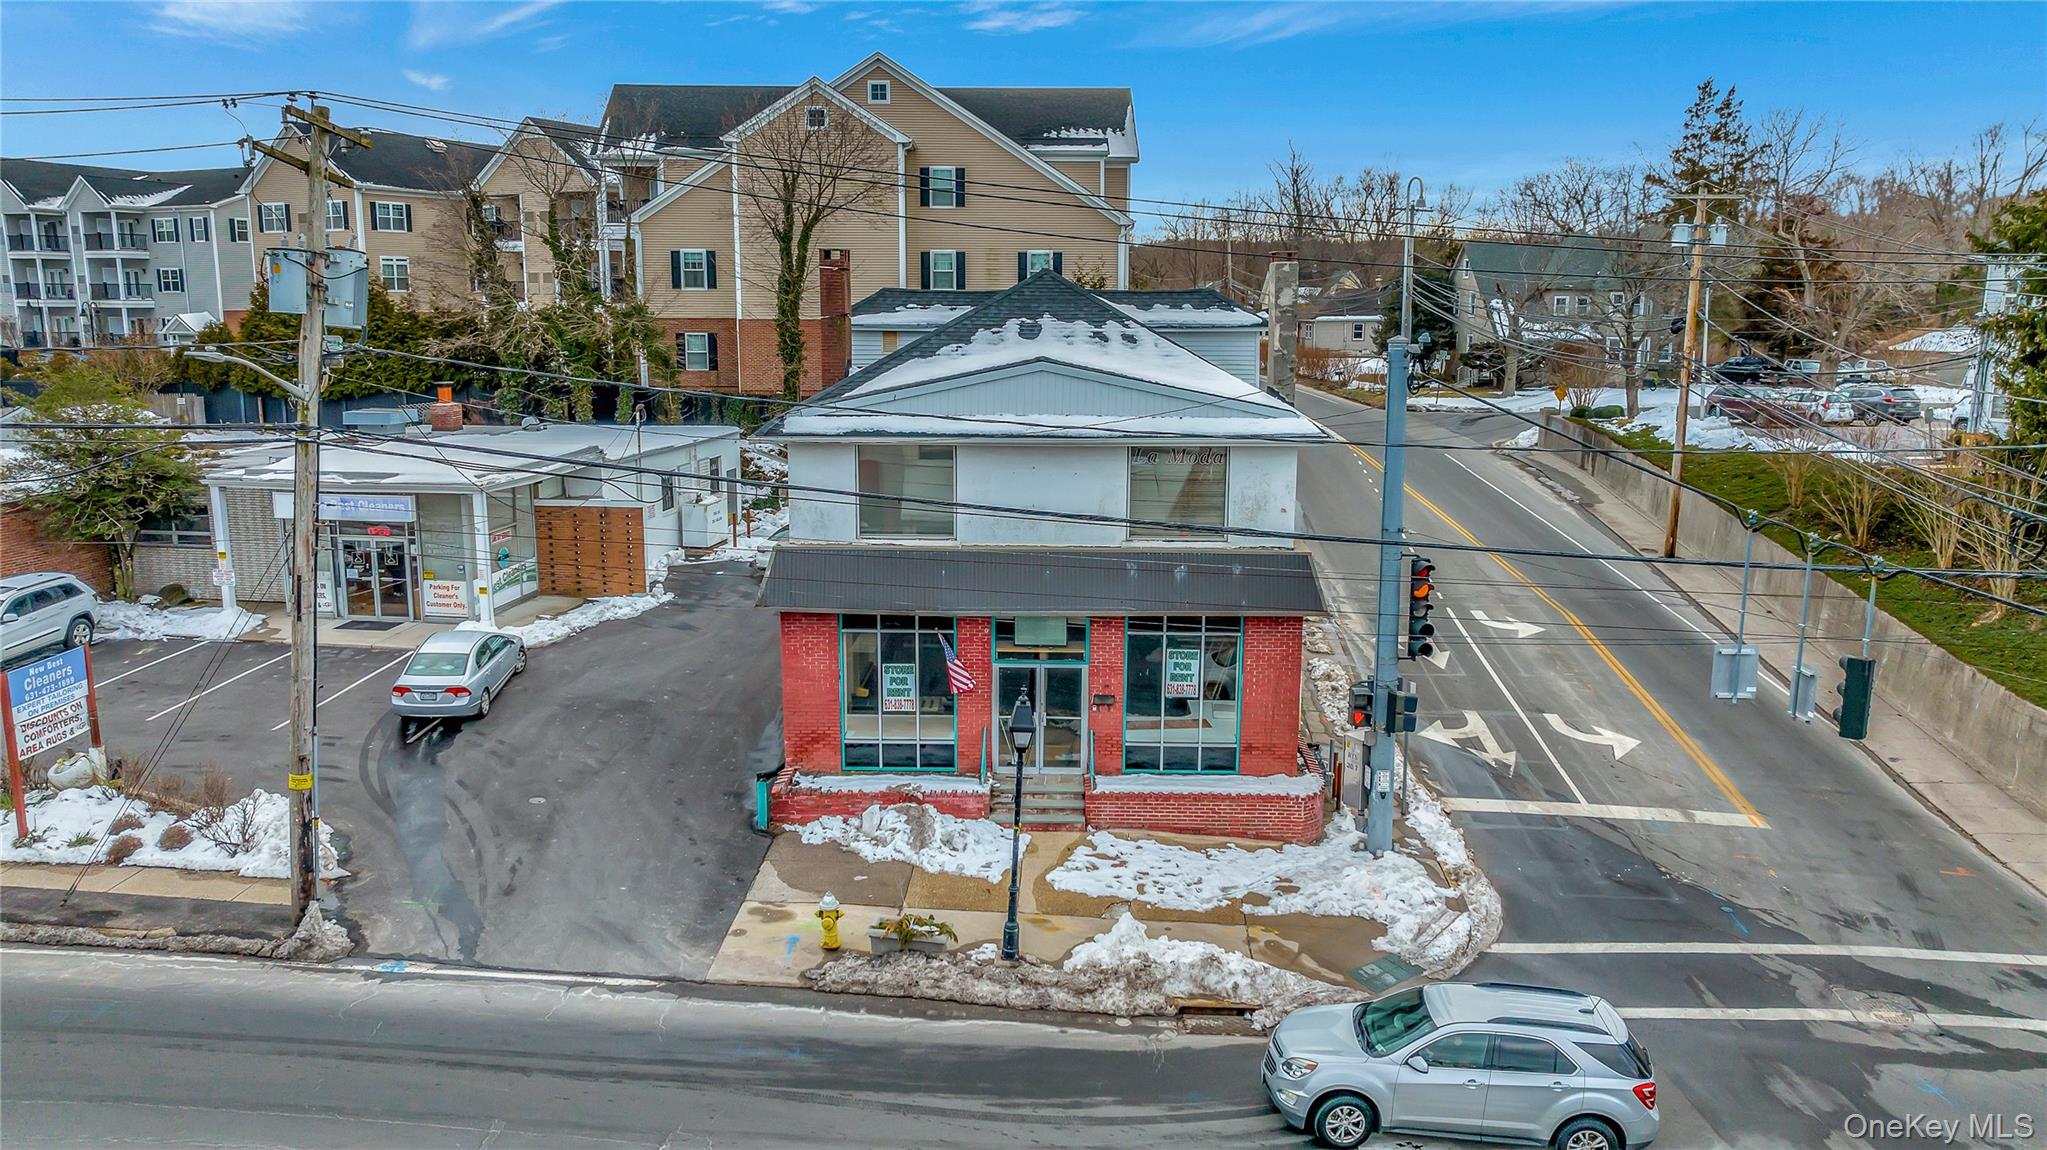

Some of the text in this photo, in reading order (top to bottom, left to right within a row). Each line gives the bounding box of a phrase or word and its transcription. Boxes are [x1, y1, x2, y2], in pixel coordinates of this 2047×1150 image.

[1133, 447, 1225, 465] La Moda
[359, 501, 406, 512] Cleaners
[1168, 650, 1199, 660] STORE
[29, 657, 64, 676] New Best
[884, 665, 914, 675] STORE
[1173, 661, 1192, 671] FOR
[24, 665, 73, 691] Cleaners
[889, 676, 909, 686] FOR
[1169, 672, 1195, 682] RENT
[16, 682, 84, 713] EXPERT TAILORING
[886, 687, 912, 697] RENT
[27, 694, 75, 717] ON PREMISES
[20, 707, 69, 733] DISCOUNTS
[70, 701, 83, 713] ON
[23, 713, 83, 744] COMFORTERS,
[19, 727, 75, 758] AREA RUGS &
